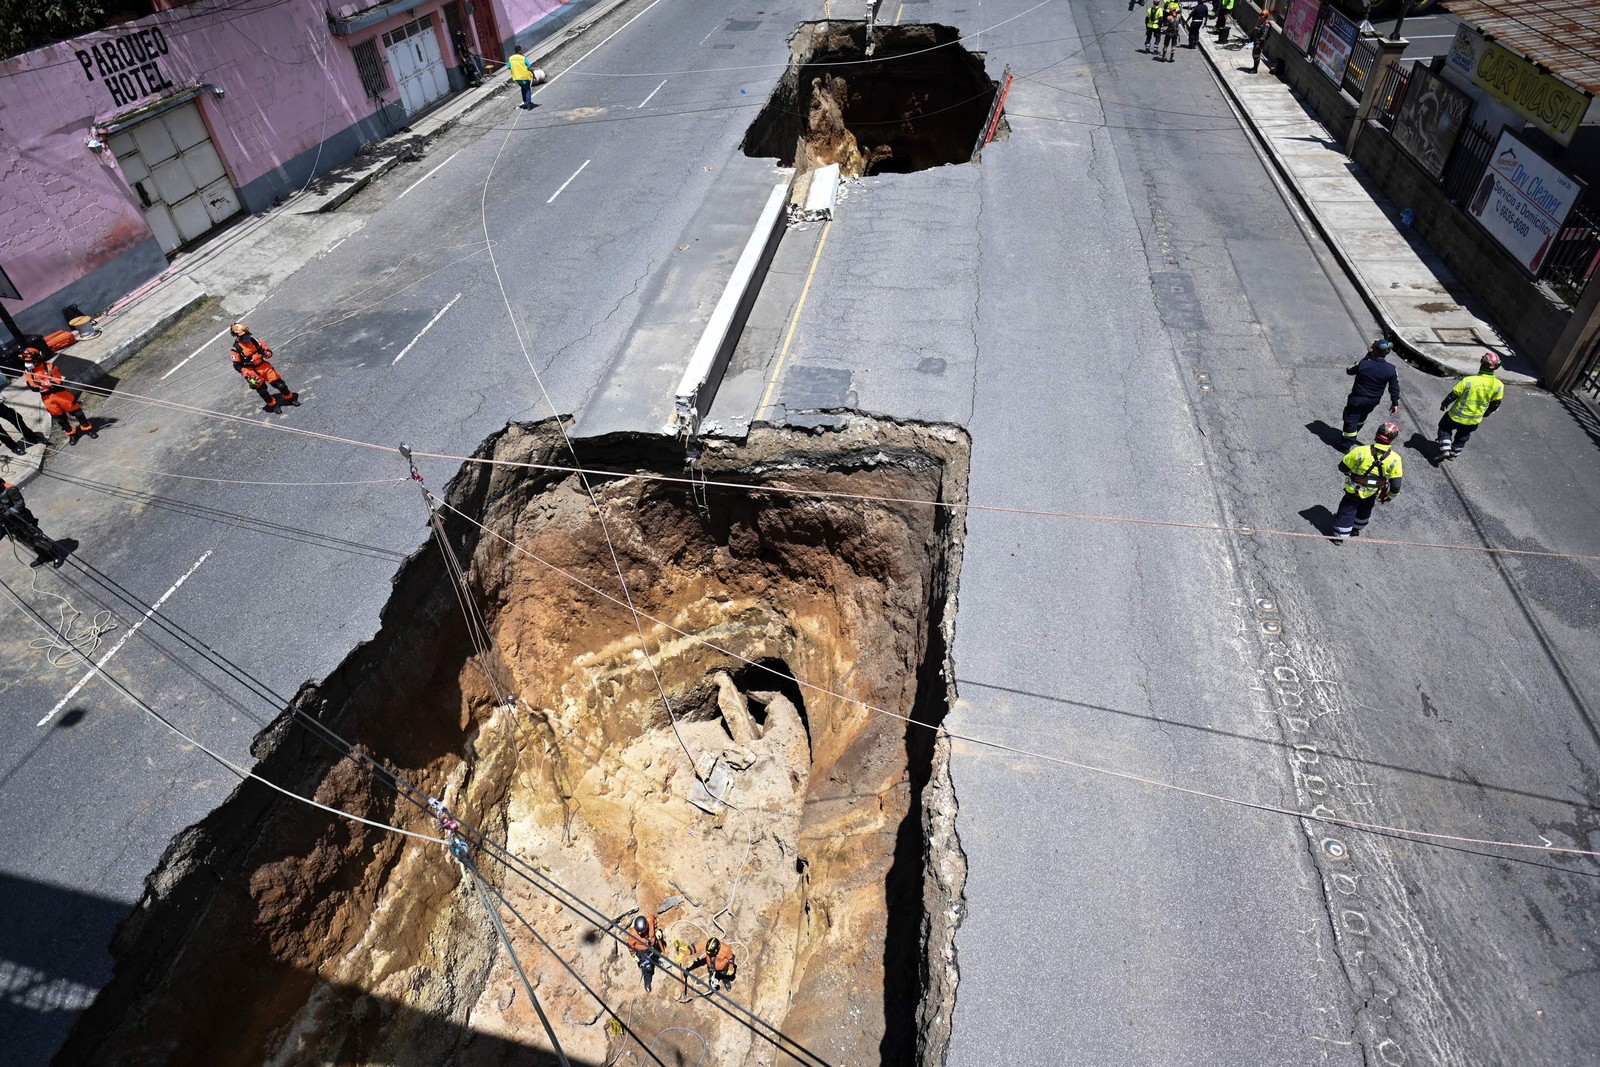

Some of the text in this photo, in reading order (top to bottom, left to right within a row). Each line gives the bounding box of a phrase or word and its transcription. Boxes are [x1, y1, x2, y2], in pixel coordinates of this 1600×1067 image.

[75, 26, 169, 81] PARQUEO
[104, 61, 173, 107] HOTEL
[1477, 49, 1582, 133] CAR WASH
[1494, 180, 1550, 236] Servicio a Domicilio
[1511, 163, 1562, 215] Dry Cleaner
